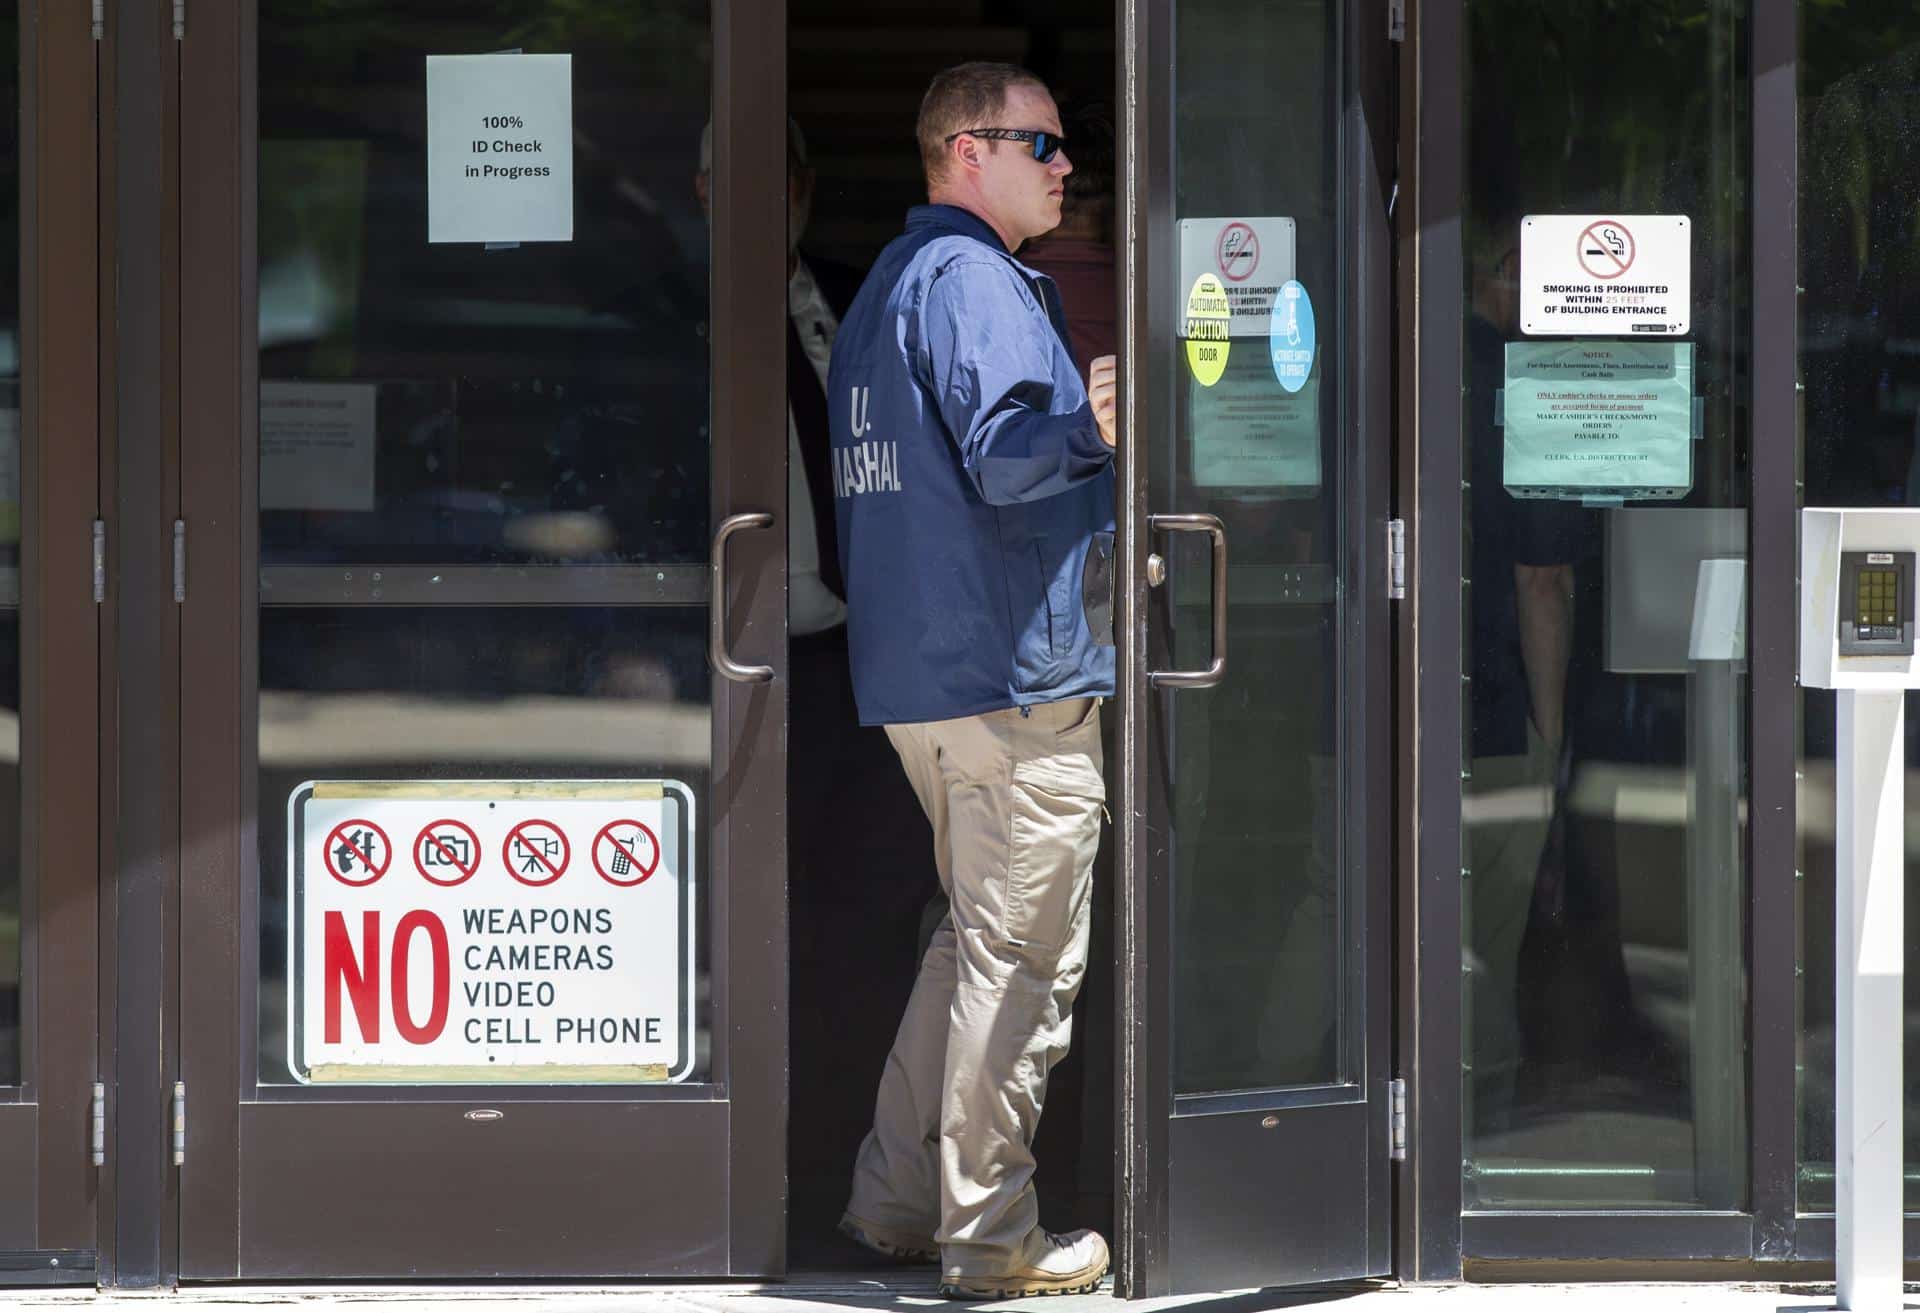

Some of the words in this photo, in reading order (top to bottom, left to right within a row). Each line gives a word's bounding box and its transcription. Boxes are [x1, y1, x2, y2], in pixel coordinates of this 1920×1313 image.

[482, 116, 523, 128] 100%
[472, 141, 488, 153] ID
[492, 140, 542, 153] Check
[465, 165, 479, 177] in
[483, 165, 550, 180] Progress
[1543, 285, 1591, 293] SMOKING
[1594, 285, 1604, 293] IS
[1607, 285, 1668, 293] PROHIBITED
[1190, 298, 1227, 312] AUTOMATIC
[1565, 296, 1603, 304] WITHIN
[1606, 296, 1618, 304] 25
[1621, 296, 1646, 304] FEET
[1544, 306, 1558, 314] OF
[1560, 306, 1609, 314] BUILDING
[1612, 306, 1668, 315] ENTRANCE
[1188, 320, 1229, 341] CAUTION
[1199, 348, 1218, 361] DOOR
[1574, 432, 1605, 440] PAYABLE
[463, 908, 613, 934] WEAPONS
[464, 945, 614, 971] CAMERAS
[324, 909, 450, 1045] NO
[463, 981, 555, 1007] VIDEO
[464, 1018, 541, 1044] CELL
[556, 1018, 661, 1043] PHONE
